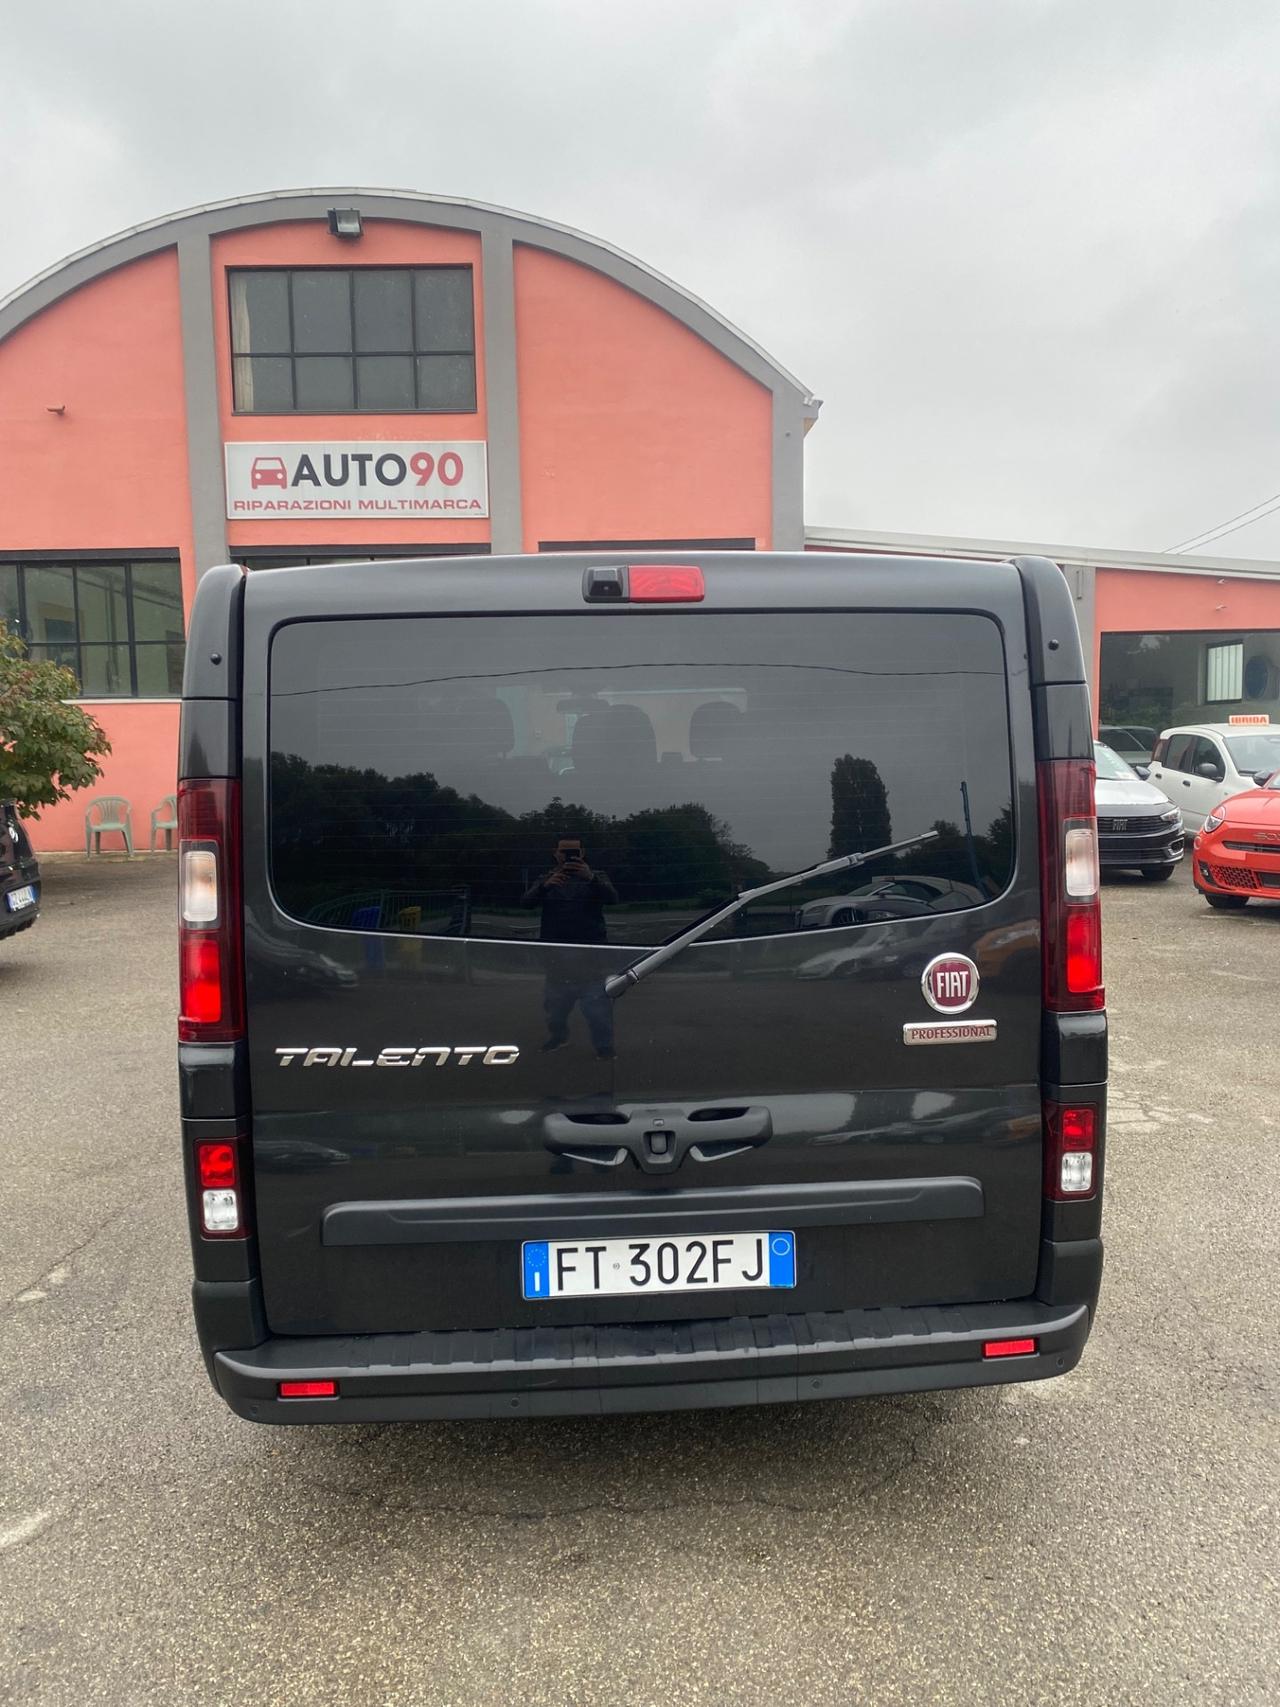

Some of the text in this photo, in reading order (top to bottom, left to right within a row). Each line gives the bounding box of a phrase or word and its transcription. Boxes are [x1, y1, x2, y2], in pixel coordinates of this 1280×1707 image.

[291, 452, 464, 487] AUTO90
[234, 499, 482, 511] RIPARAZIONI MULTIMARCA
[1231, 716, 1267, 724] IBRIDA
[936, 971, 969, 998] FIAT
[911, 1025, 992, 1040] PROFESSIONAL
[275, 1045, 520, 1067] TALENTO
[556, 1238, 763, 1291] FT 302FJ
